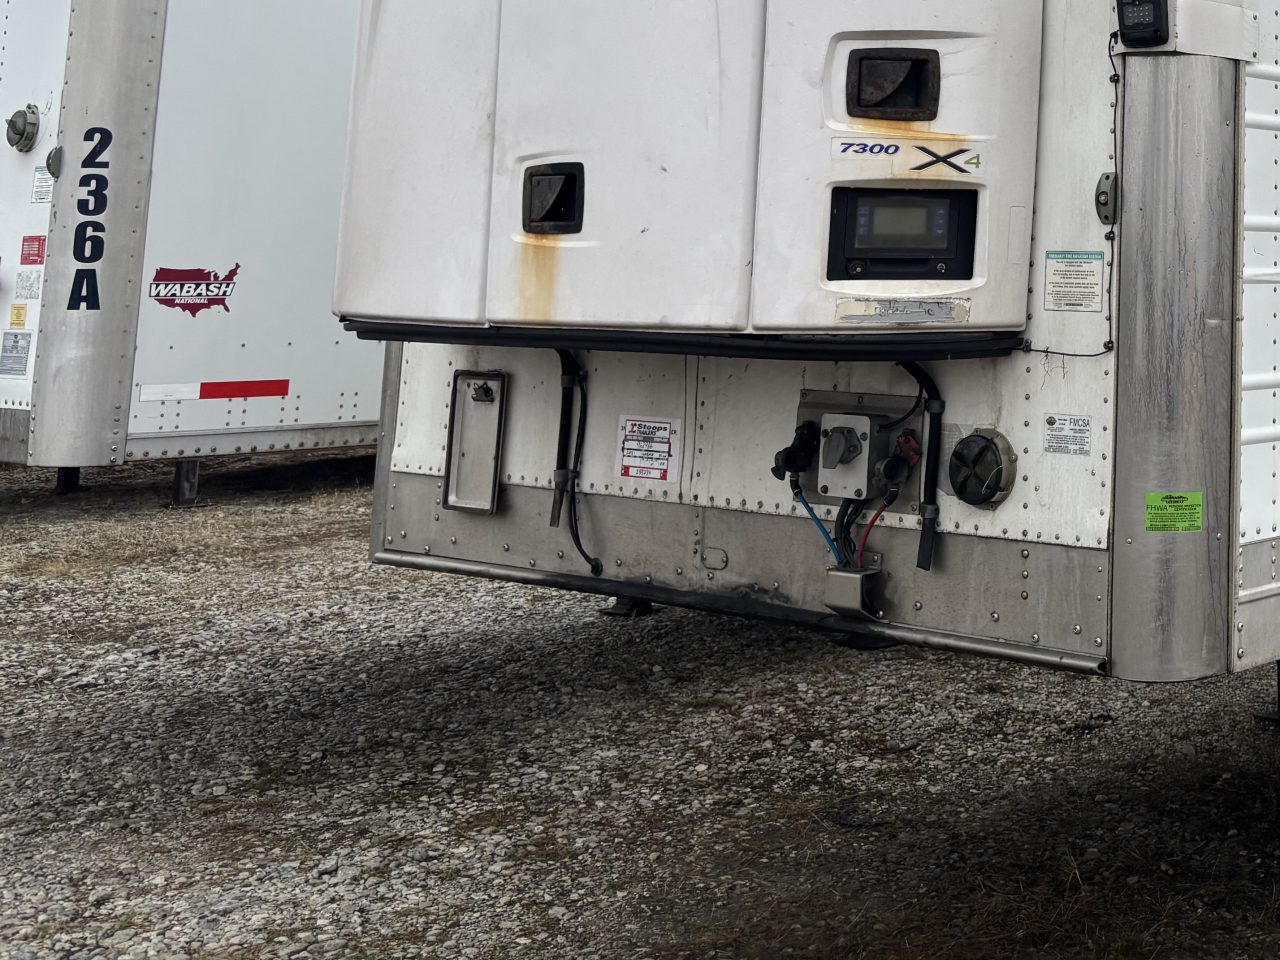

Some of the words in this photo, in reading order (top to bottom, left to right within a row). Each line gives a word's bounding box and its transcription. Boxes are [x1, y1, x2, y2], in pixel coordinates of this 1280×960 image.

[840, 142, 900, 155] 7300
[67, 127, 113, 310] 236A
[150, 283, 235, 297] WABASH
[637, 423, 668, 432] Stoops
[1069, 417, 1090, 427] FMCSA
